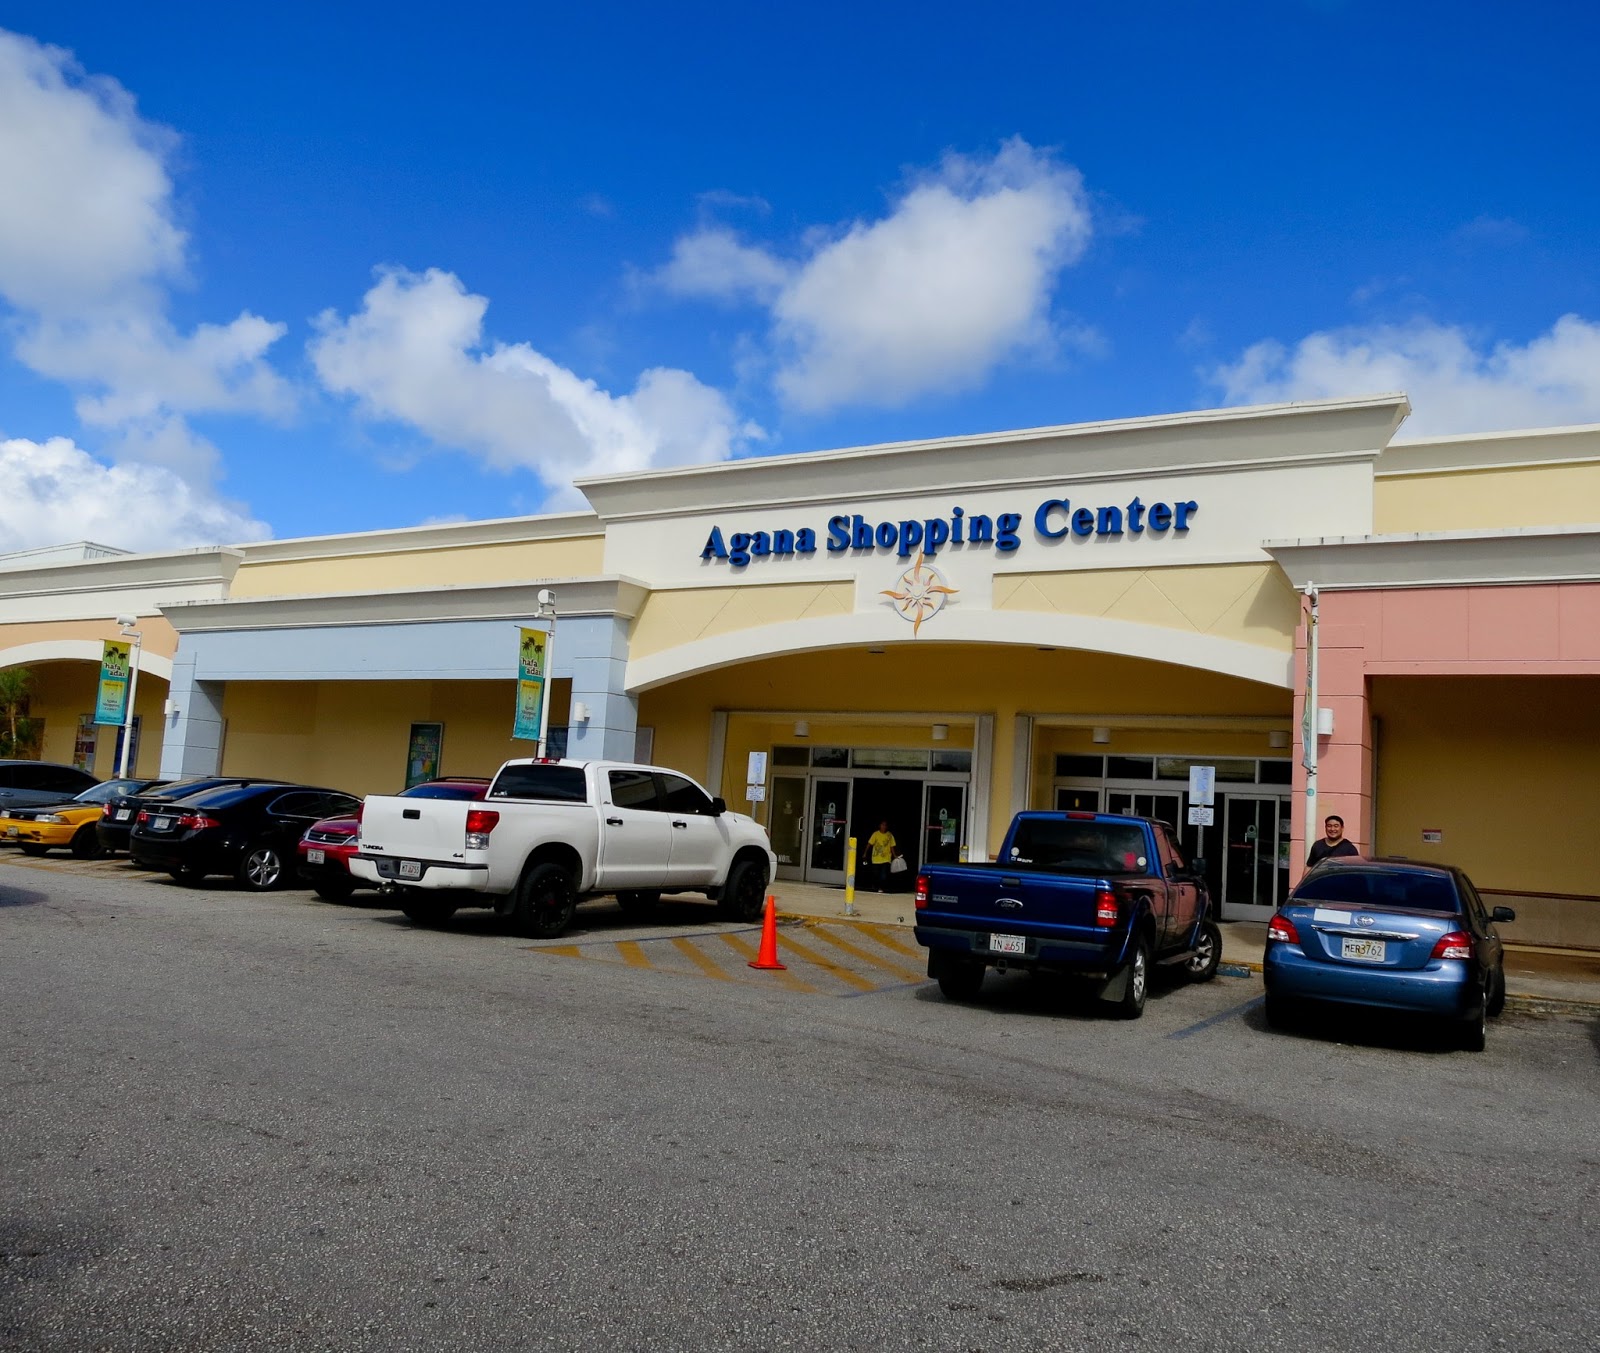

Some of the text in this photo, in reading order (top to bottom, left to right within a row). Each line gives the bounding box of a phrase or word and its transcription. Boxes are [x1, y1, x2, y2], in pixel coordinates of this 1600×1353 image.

[700, 495, 1198, 566] Agana Shopping Center
[1344, 944, 1383, 957] MER3762
